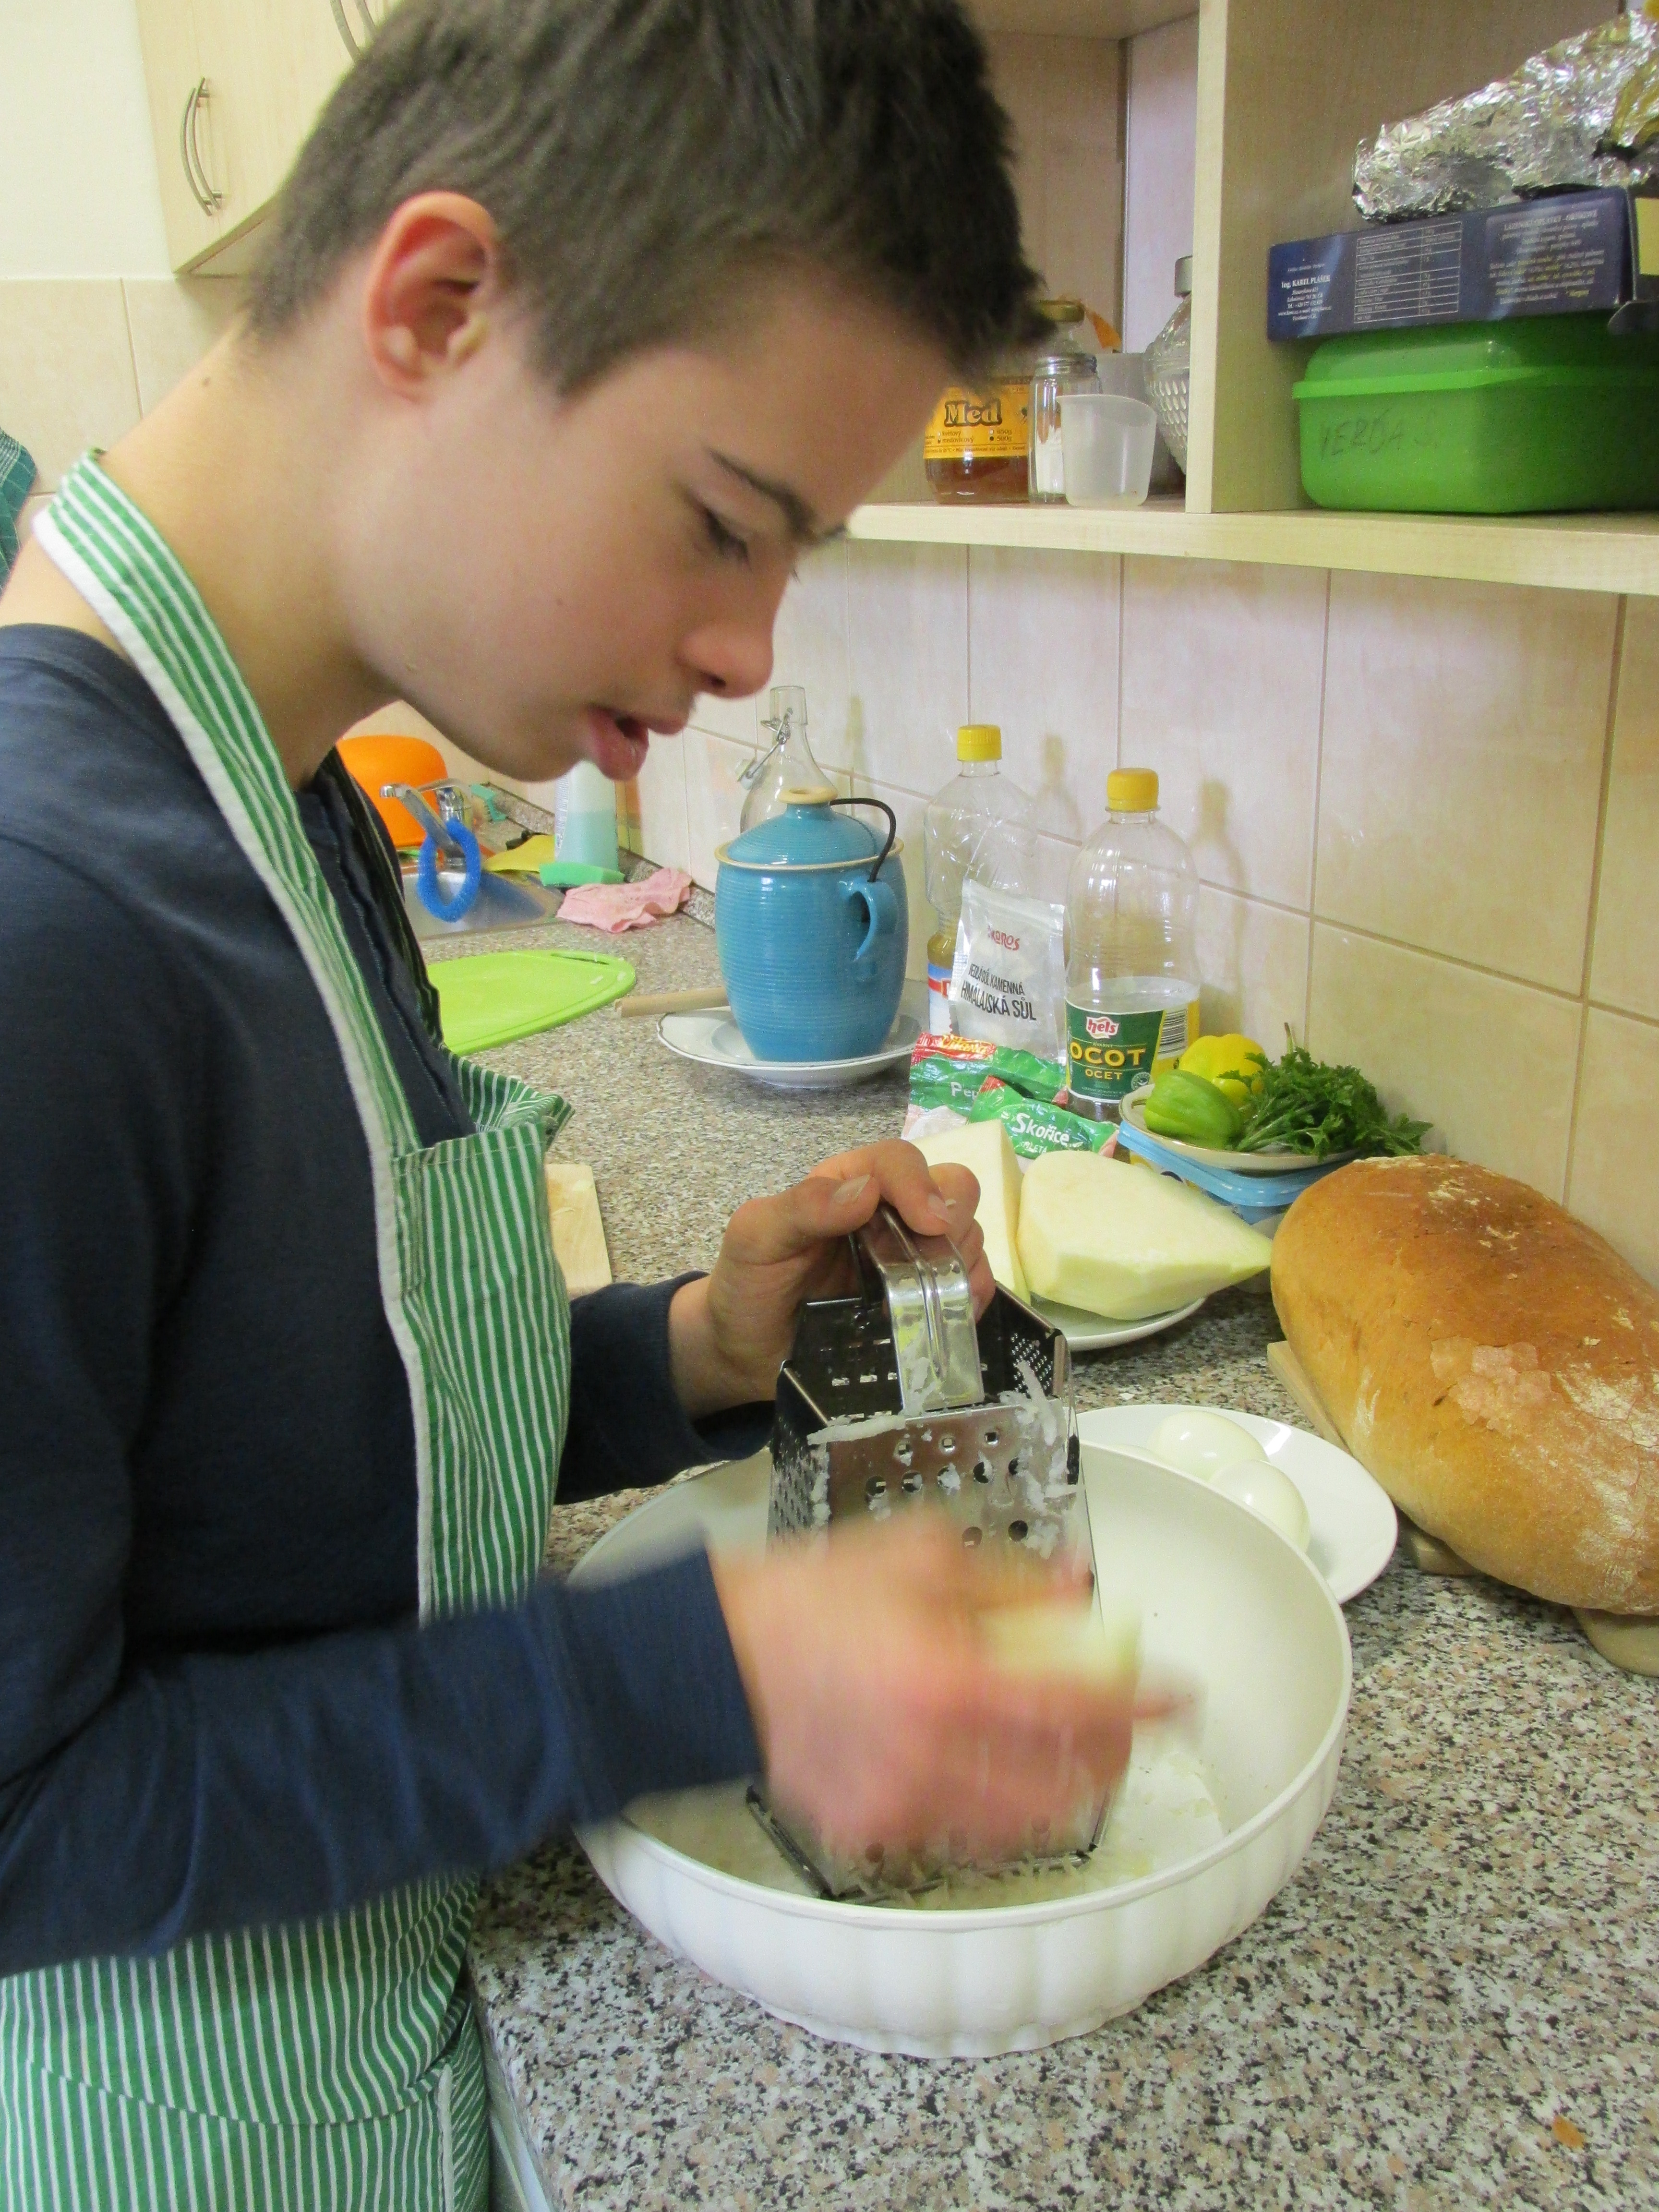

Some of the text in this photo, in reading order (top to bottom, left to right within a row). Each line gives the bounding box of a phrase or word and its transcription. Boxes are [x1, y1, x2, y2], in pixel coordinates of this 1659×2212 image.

[1292, 278, 1310, 287] KAREL
[945, 400, 1001, 426] Med
[990, 974, 1025, 996] KAMENNÁ
[961, 980, 1037, 1021] HIMÁLAJSKÁ SŮL
[1087, 1019, 1118, 1034] hels
[1070, 1041, 1146, 1067] OCOT
[1085, 1069, 1123, 1080] OCET
[950, 1082, 978, 1100] Pep
[1011, 1113, 1070, 1147] Skořice
